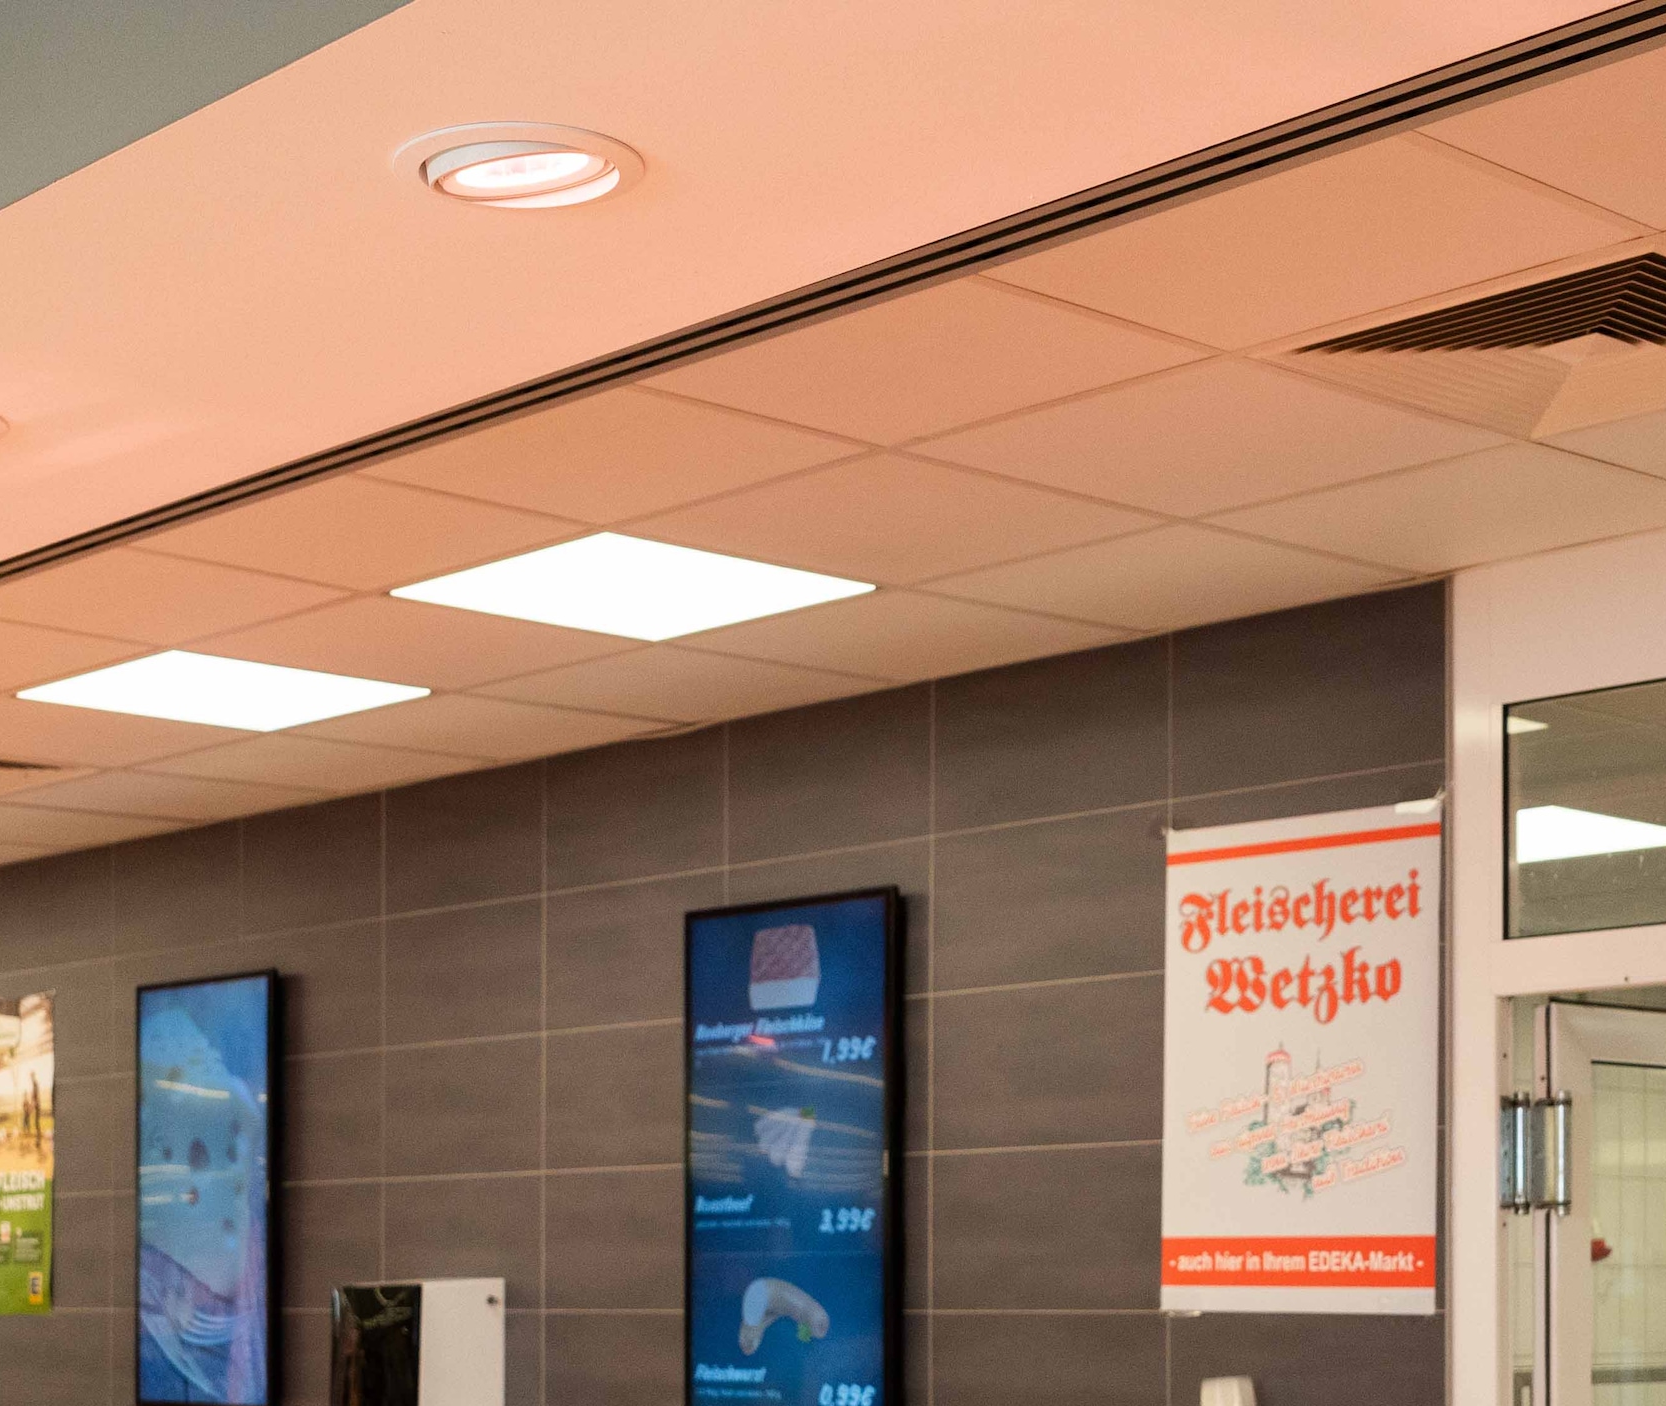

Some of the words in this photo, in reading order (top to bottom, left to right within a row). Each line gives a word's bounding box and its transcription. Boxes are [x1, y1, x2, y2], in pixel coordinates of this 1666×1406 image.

[1178, 868, 1422, 954] Fleischerei
[1204, 947, 1402, 1025] Wetzko
[1177, 1251, 1212, 1272] auch
[1215, 1251, 1243, 1272] hier
[1246, 1251, 1261, 1272] in
[1263, 1251, 1306, 1272] Ihrem
[1308, 1249, 1415, 1273] EDEKA-Markt
